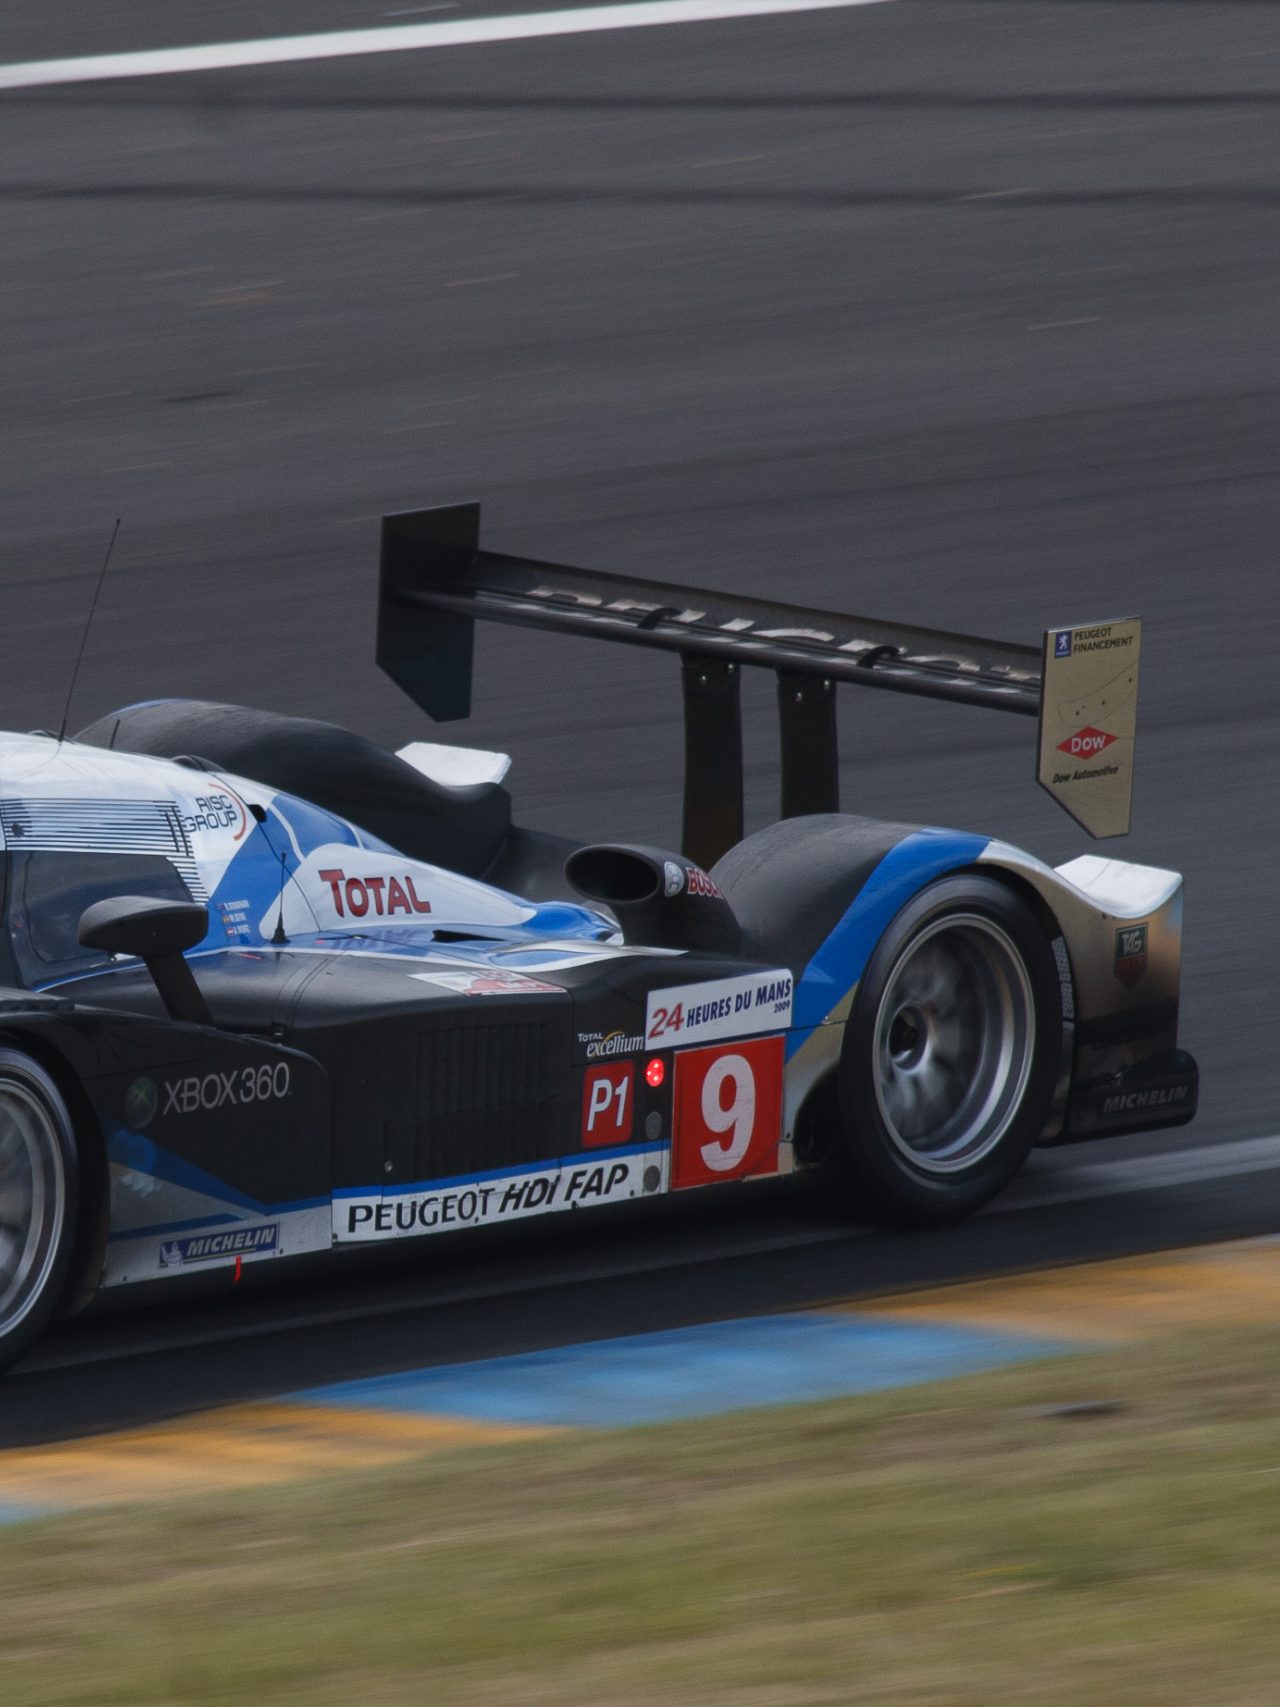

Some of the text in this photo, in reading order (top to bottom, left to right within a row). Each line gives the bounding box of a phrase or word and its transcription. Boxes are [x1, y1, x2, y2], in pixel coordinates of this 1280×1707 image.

[1073, 636, 1134, 653] FINANCEMENT
[1074, 627, 1113, 641] PEUGEOT
[1071, 735, 1106, 753] DOW
[1053, 766, 1119, 784] Dow Automotive
[196, 795, 233, 812] RISC
[184, 810, 238, 833] GROUP
[318, 869, 431, 918] TOTAL
[648, 978, 791, 1040] 24 HEURES DU MANS
[773, 1000, 791, 1015] 2009
[577, 1032, 604, 1043] TOTAL
[586, 1034, 644, 1058] excellium
[239, 1062, 291, 1104] 360
[587, 1076, 629, 1132] P1
[1102, 1085, 1188, 1114] MICHELIN
[700, 1054, 756, 1172] 9
[348, 1187, 496, 1233] PEUGEOT
[564, 1162, 630, 1202] FAP
[186, 1228, 275, 1256] MICHELIN
